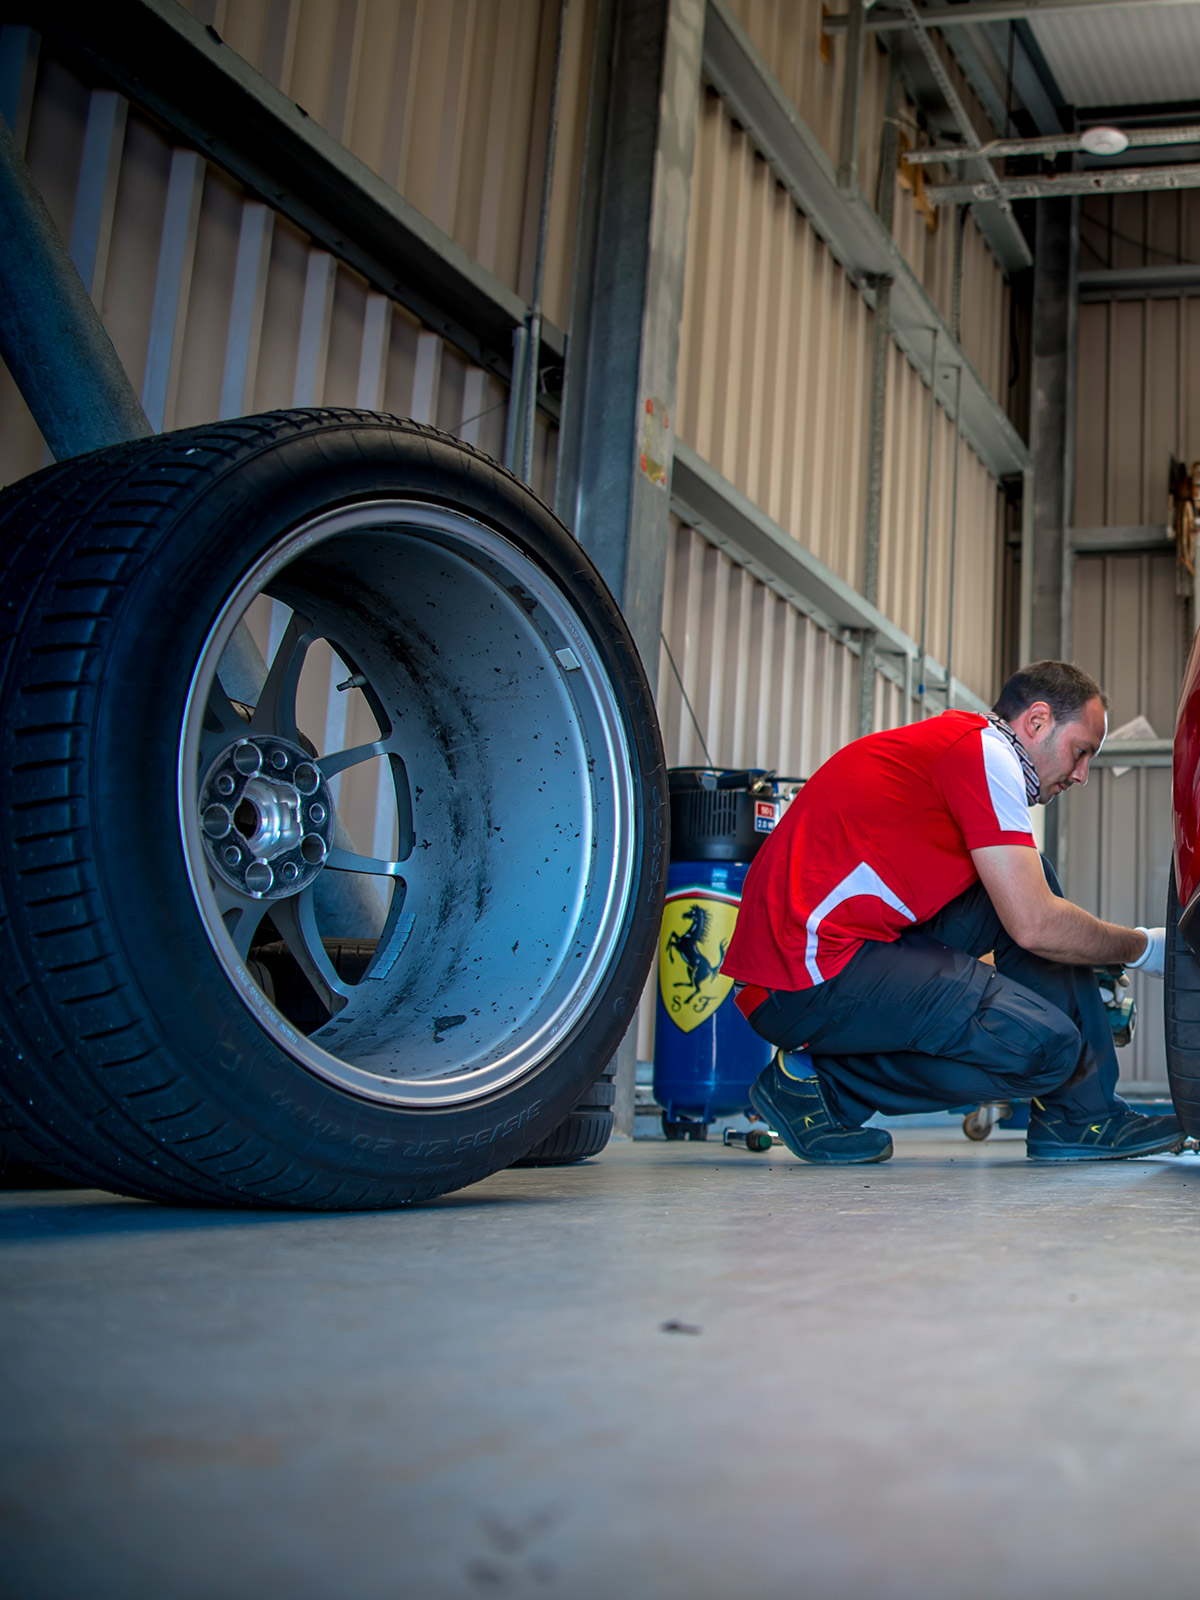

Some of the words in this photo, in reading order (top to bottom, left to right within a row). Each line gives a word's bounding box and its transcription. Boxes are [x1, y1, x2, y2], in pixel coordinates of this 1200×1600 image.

[671, 995, 682, 1013] S
[693, 995, 718, 1013] F
[453, 1099, 542, 1154] 315/35
[350, 1134, 398, 1155] 20
[402, 1139, 450, 1158] ZR
